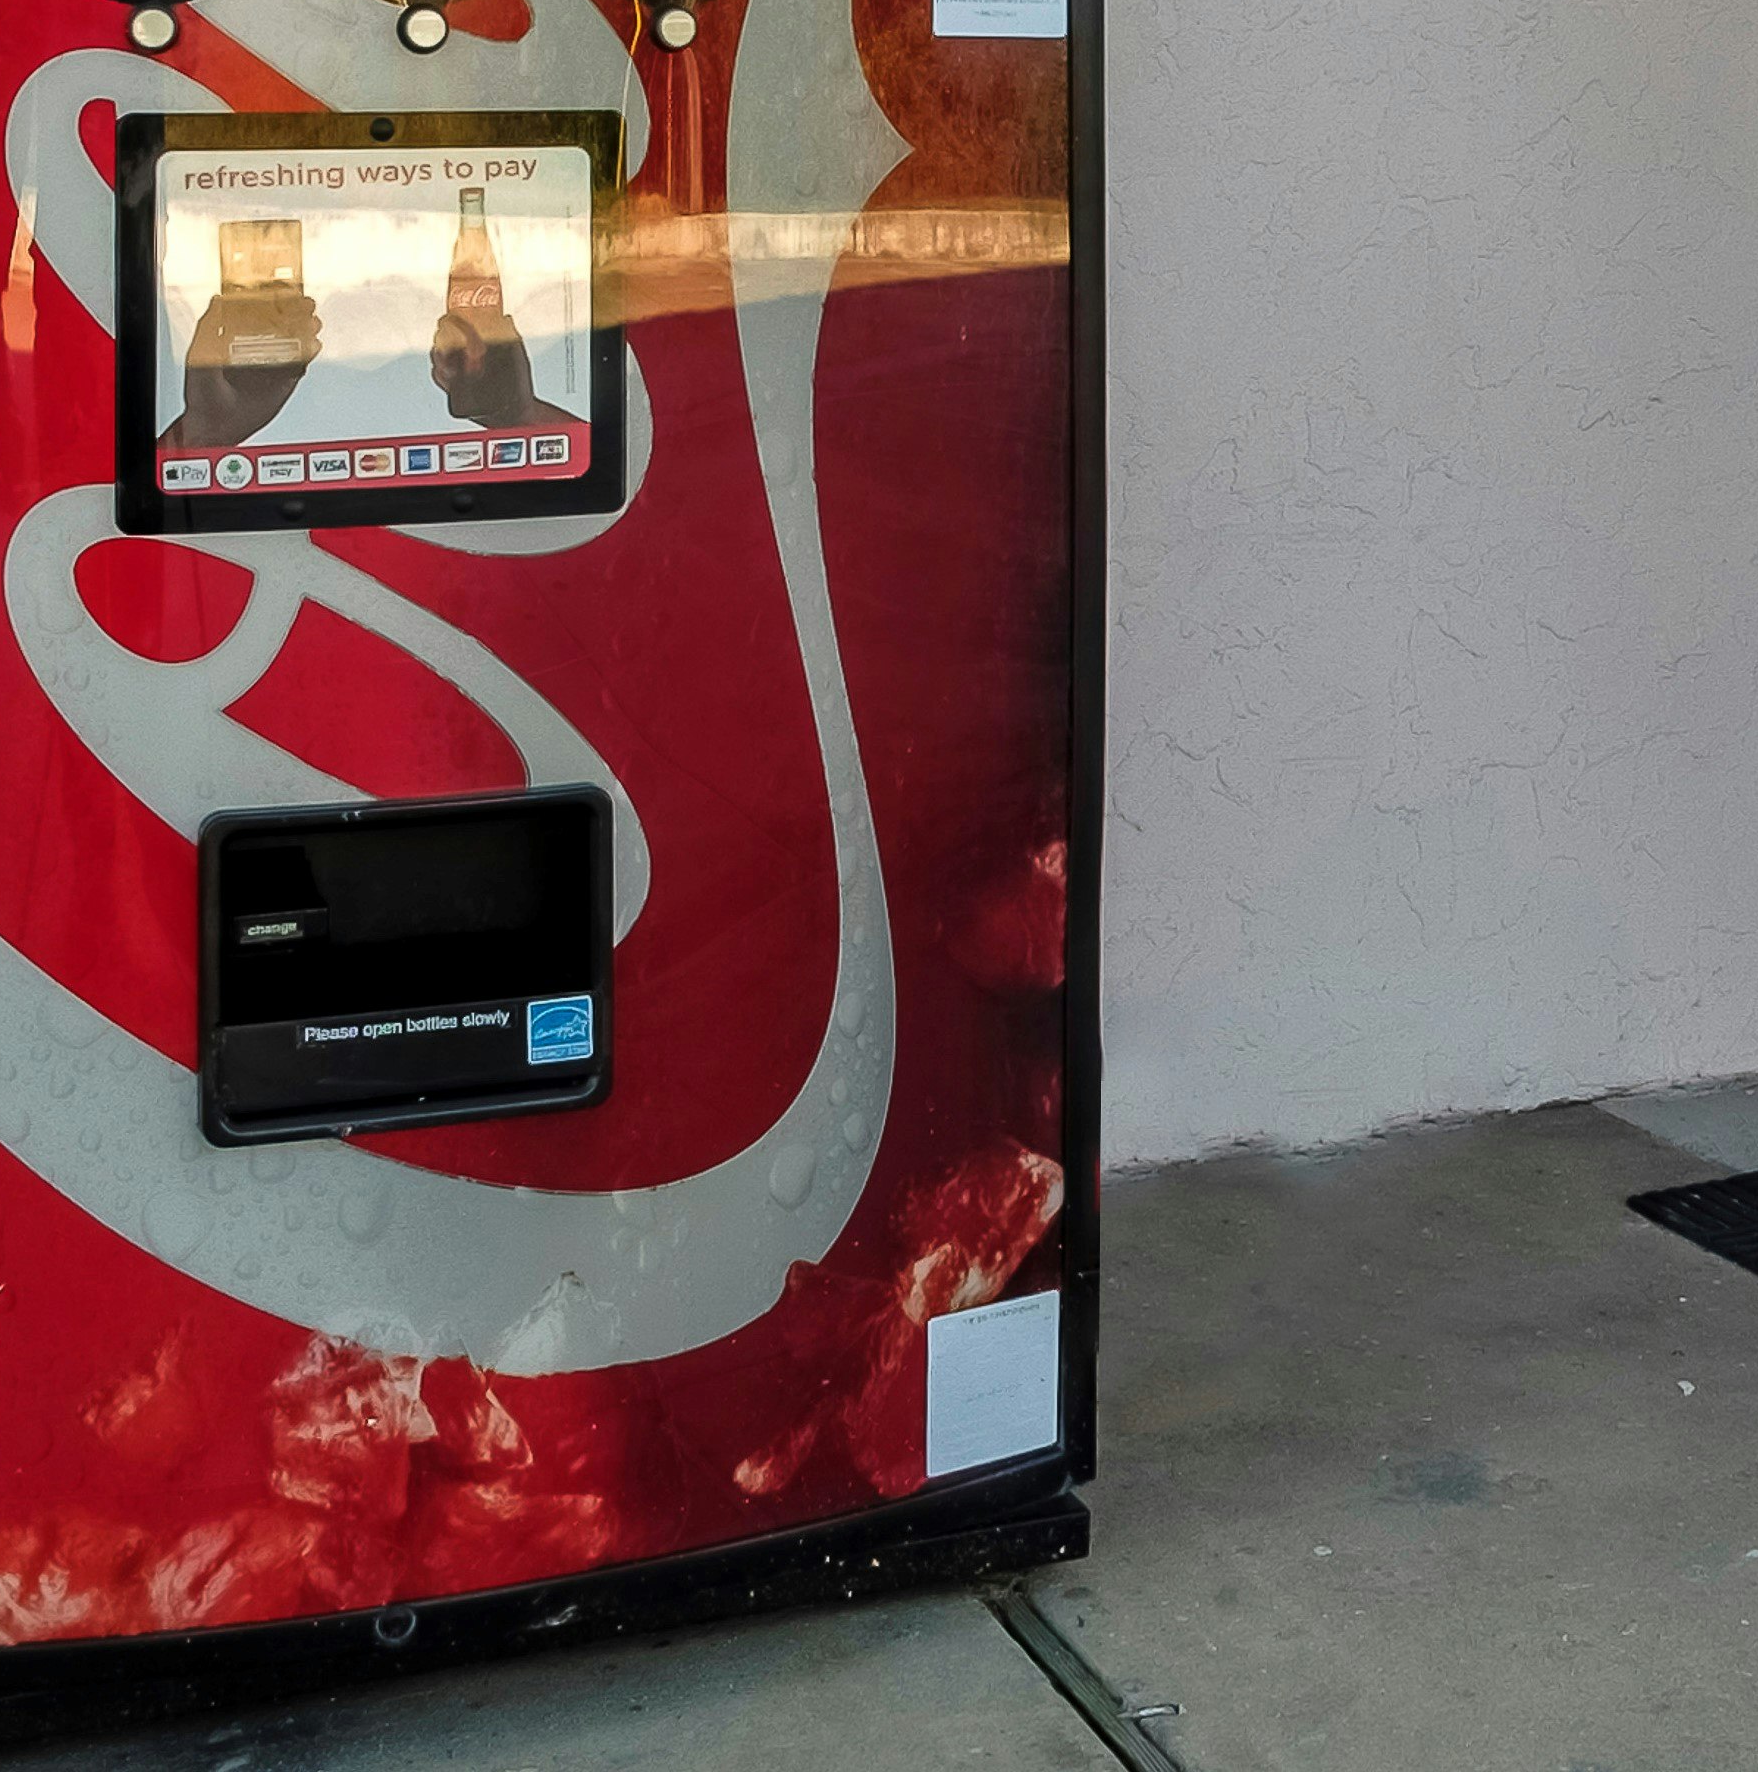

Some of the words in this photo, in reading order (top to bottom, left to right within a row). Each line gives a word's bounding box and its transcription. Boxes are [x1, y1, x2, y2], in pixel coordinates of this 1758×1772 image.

[183, 162, 346, 191] refreshing
[358, 161, 433, 185] ways
[443, 158, 473, 179] to
[484, 156, 539, 183] pay
[181, 466, 208, 483] Pay
[312, 459, 348, 473] VISA
[247, 921, 298, 939] change
[304, 1024, 359, 1044] Please
[363, 1021, 403, 1041] open
[406, 1015, 458, 1035] bottles
[462, 1010, 511, 1033] slowly
